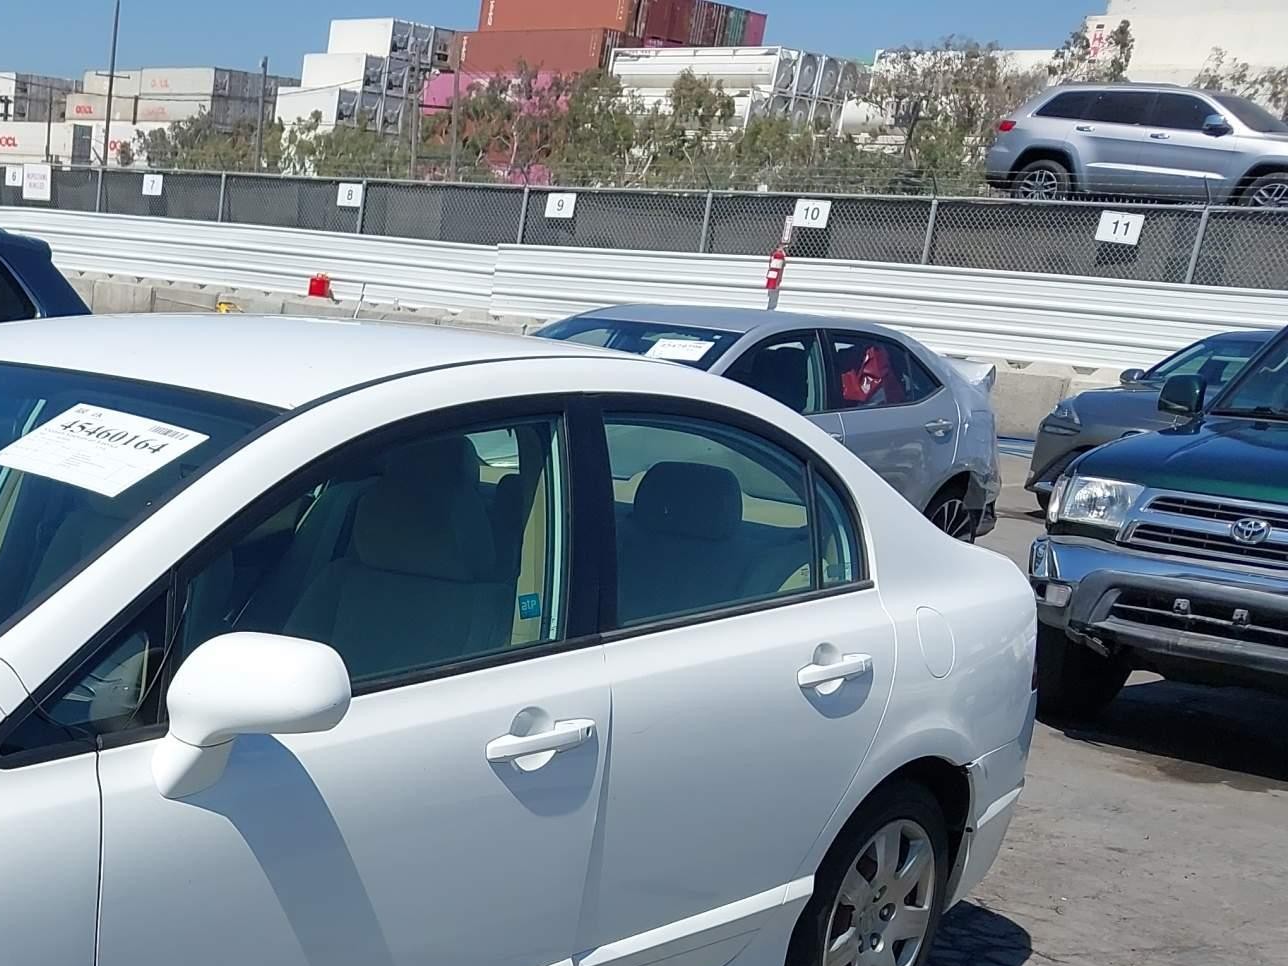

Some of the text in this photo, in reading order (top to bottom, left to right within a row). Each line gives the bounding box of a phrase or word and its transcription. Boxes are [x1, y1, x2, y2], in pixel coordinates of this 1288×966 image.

[347, 189, 353, 201] 8
[557, 199, 564, 212] 9
[804, 206, 820, 221] 10
[1112, 220, 1130, 236] 11
[60, 420, 169, 454] 45460164
